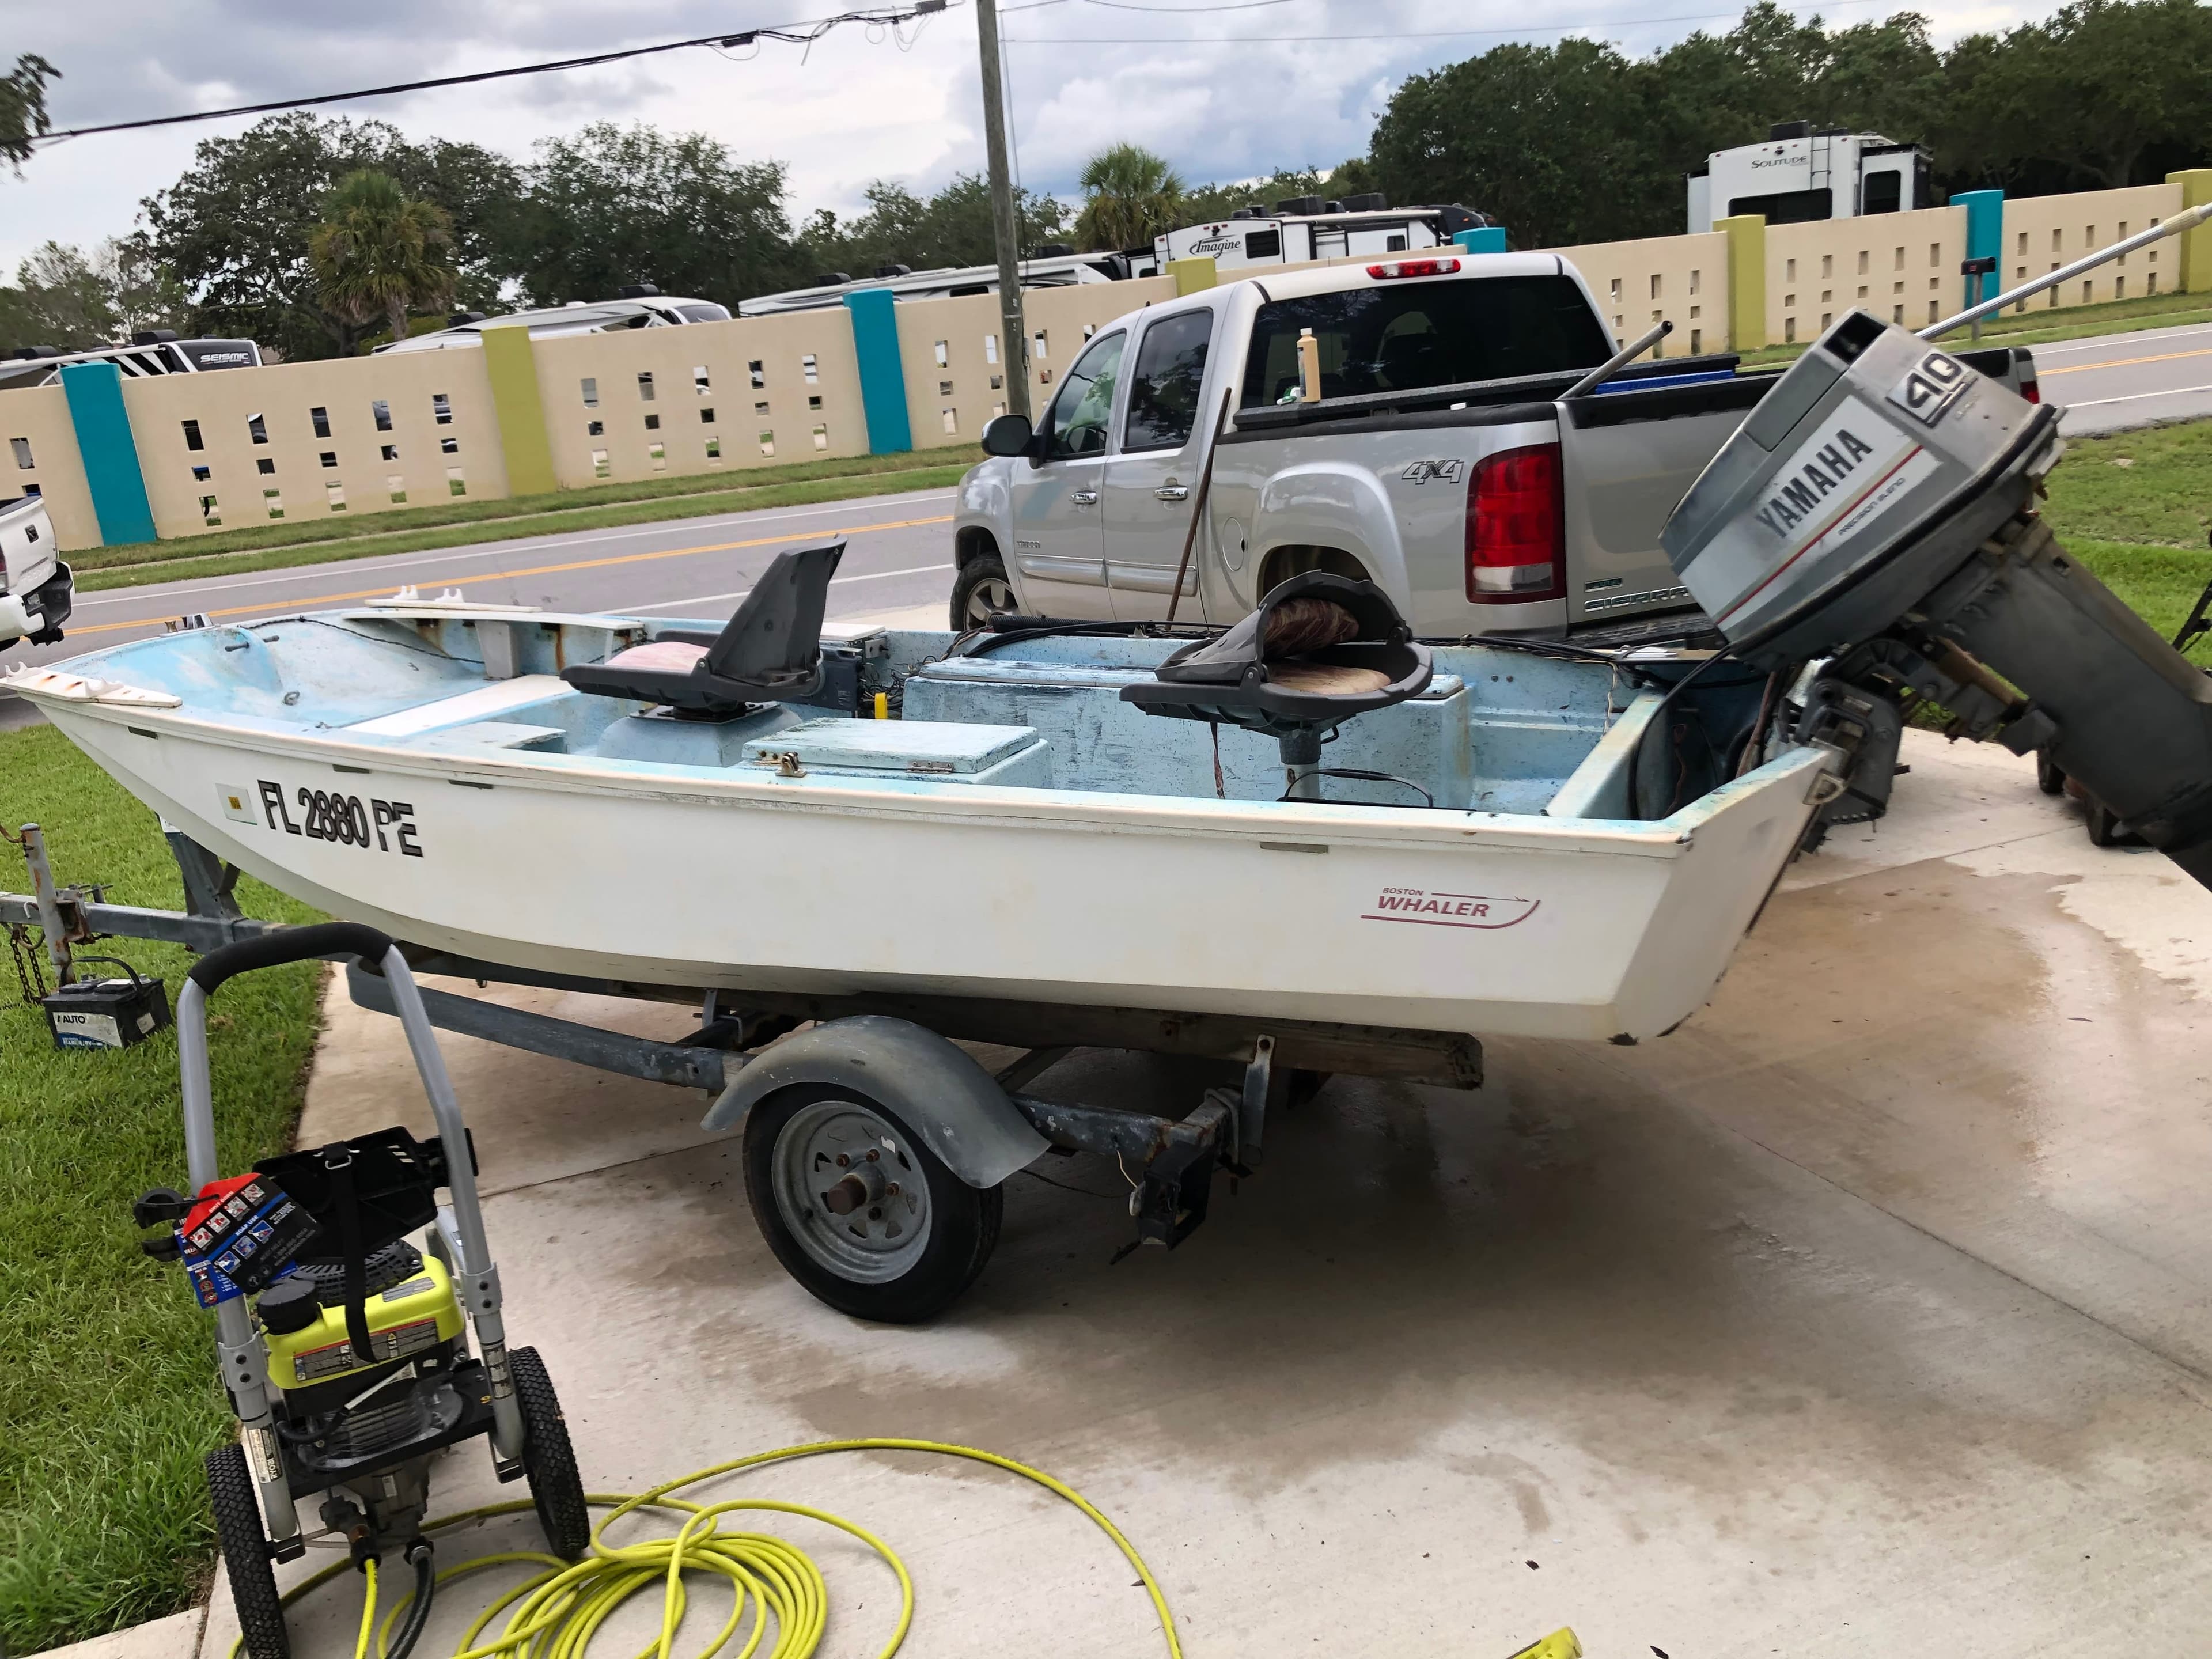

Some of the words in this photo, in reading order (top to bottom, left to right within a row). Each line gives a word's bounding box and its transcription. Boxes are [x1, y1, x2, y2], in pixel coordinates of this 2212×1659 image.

[1751, 156, 1808, 169] SOLITUDE
[1190, 237, 1241, 259] Imagine
[200, 353, 249, 363] SEISMIC
[1907, 353, 1962, 409] 40
[1756, 429, 1873, 539] YAMAHA
[1584, 585, 1690, 612] SIERRA
[257, 779, 302, 836] FL
[298, 787, 370, 849] 2880
[370, 798, 423, 857] PE
[1382, 887, 1424, 896] BOSTON
[1378, 895, 1490, 918] WHALER
[63, 1014, 86, 1024] AUTO
